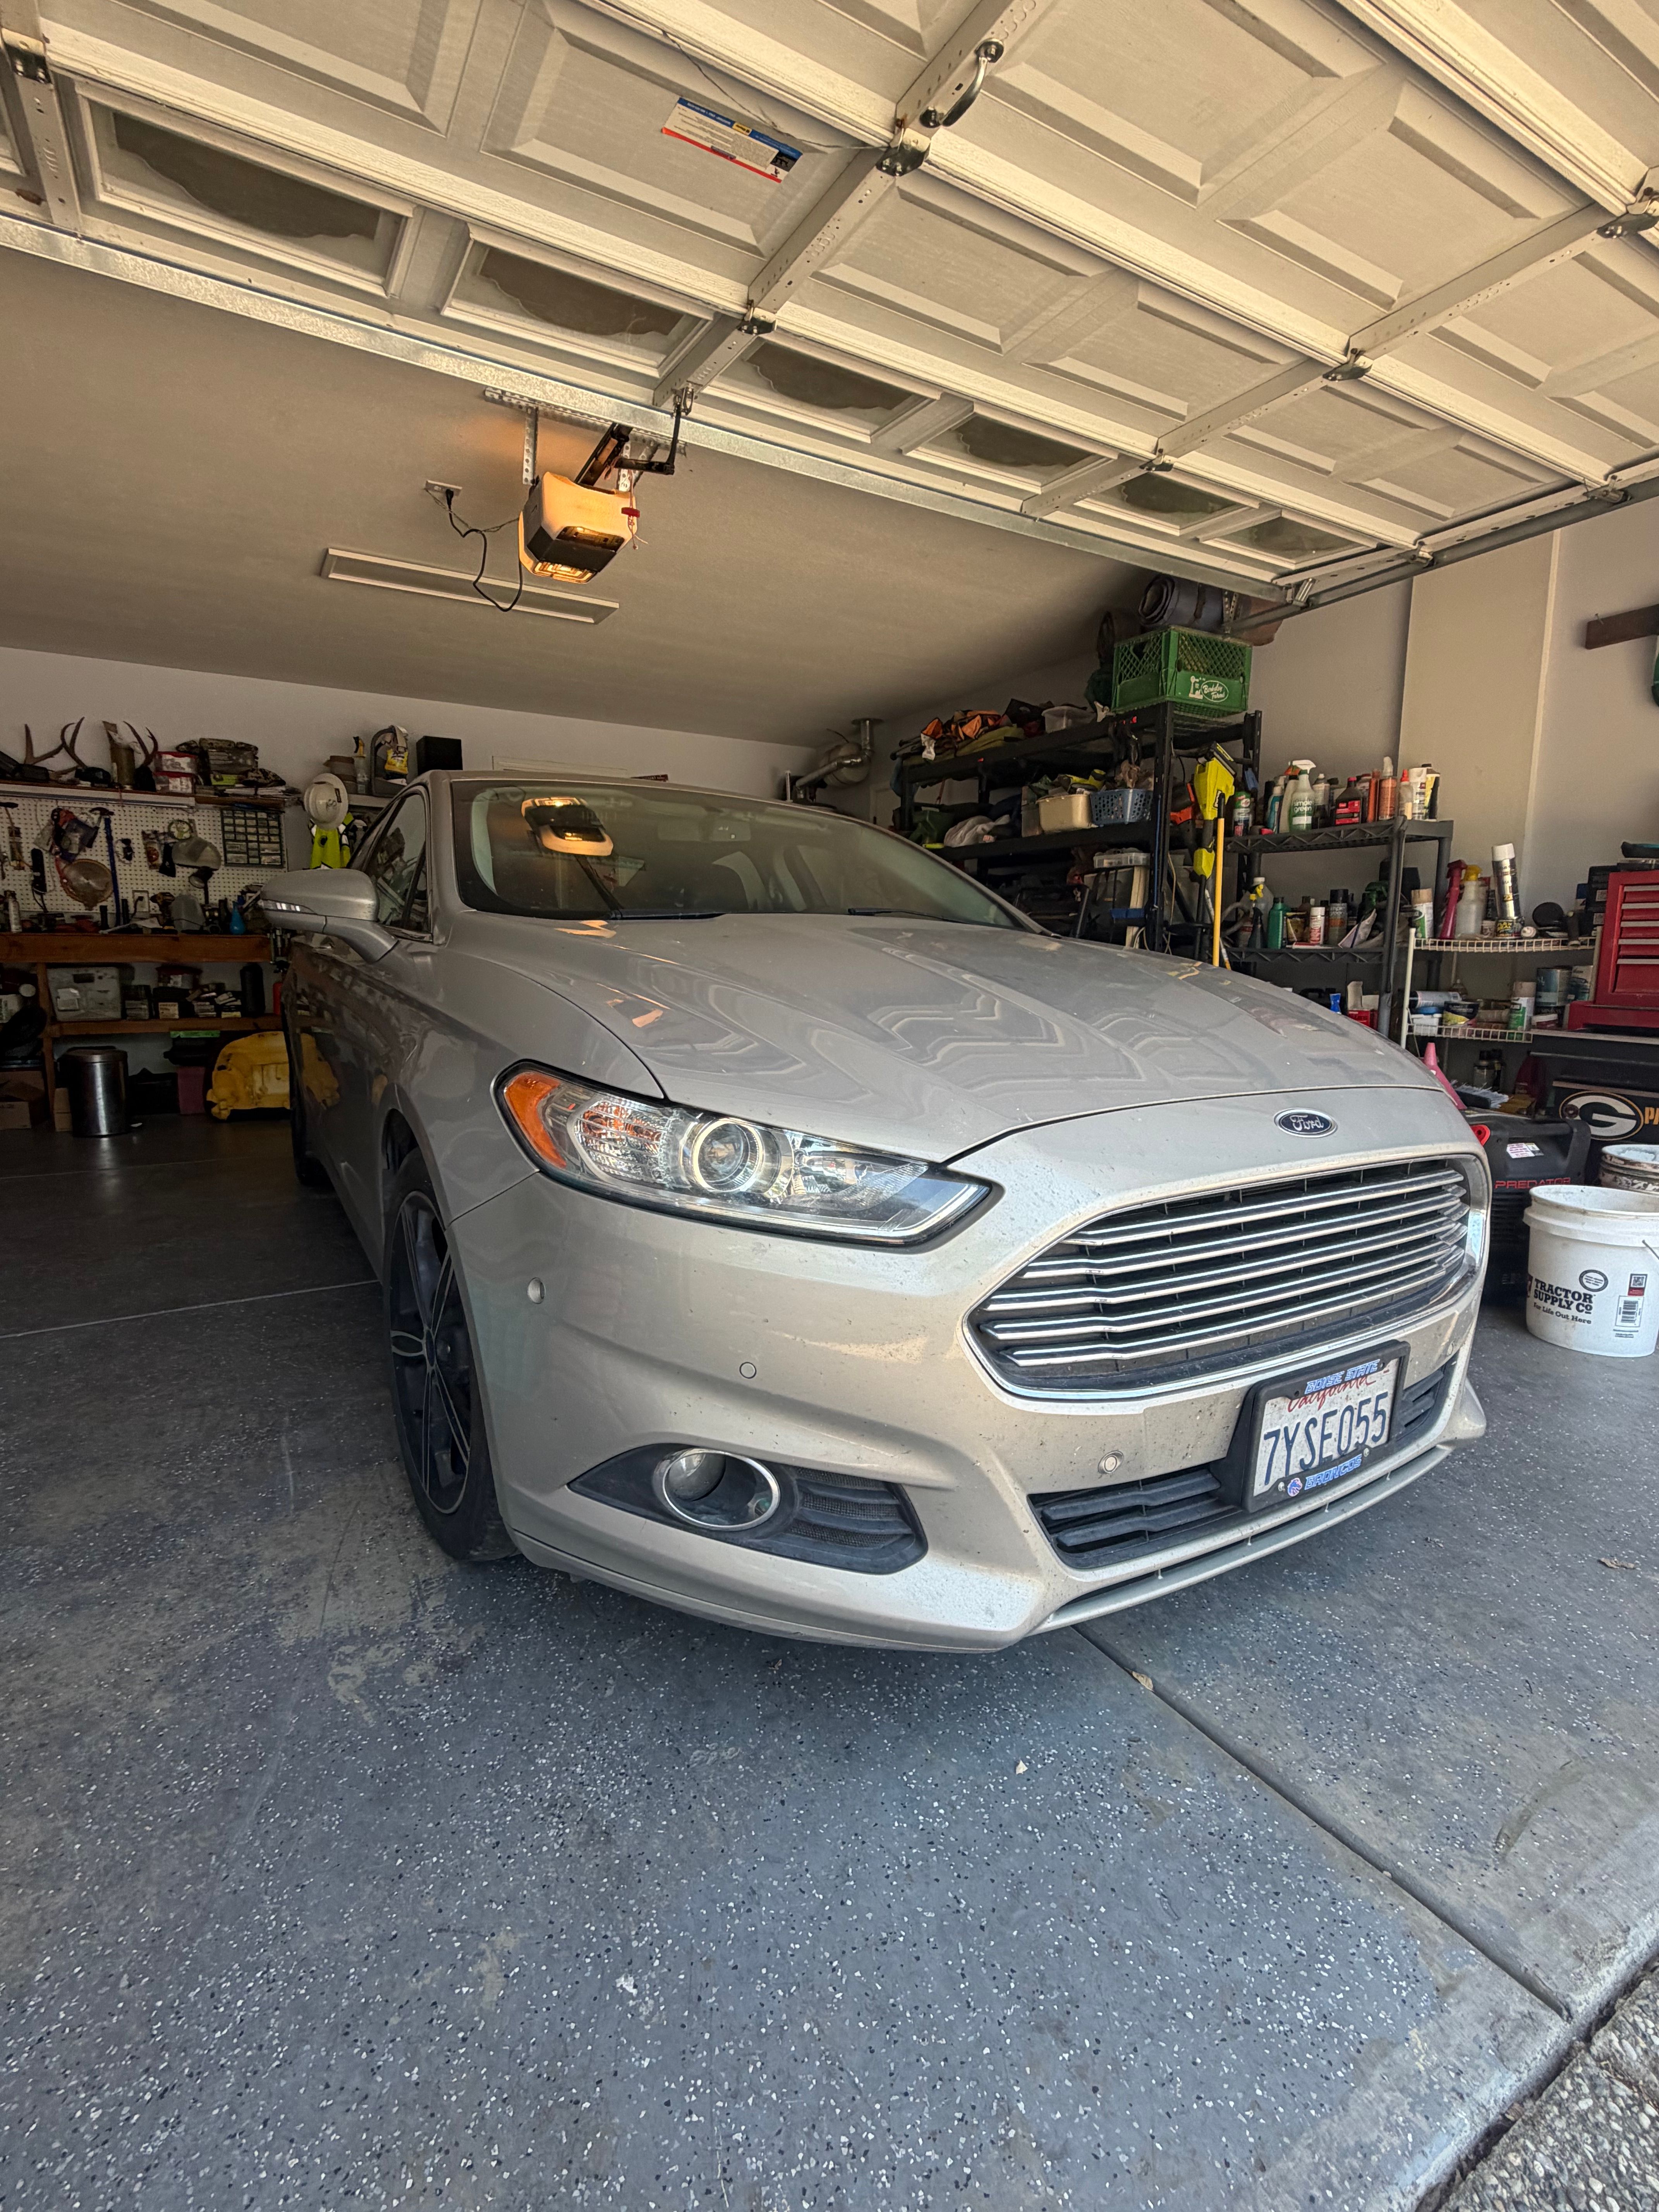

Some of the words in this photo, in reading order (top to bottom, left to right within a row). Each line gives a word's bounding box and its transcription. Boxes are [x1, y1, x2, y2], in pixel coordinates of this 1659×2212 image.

[1289, 1115, 1324, 1131] Ford
[1495, 1177, 1571, 1189] PREDATOR
[1534, 1289, 1574, 1310] SUPPLY
[1535, 1278, 1593, 1304] TRACTOR
[1542, 1306, 1554, 1315] Life
[1555, 1311, 1570, 1320] Out
[1571, 1315, 1591, 1324] Here
[1305, 1371, 1345, 1394] BOISE
[1345, 1359, 1380, 1381] STATE
[1264, 1391, 1388, 1485] 7YSE055
[1304, 1454, 1362, 1491] BRONCOS
